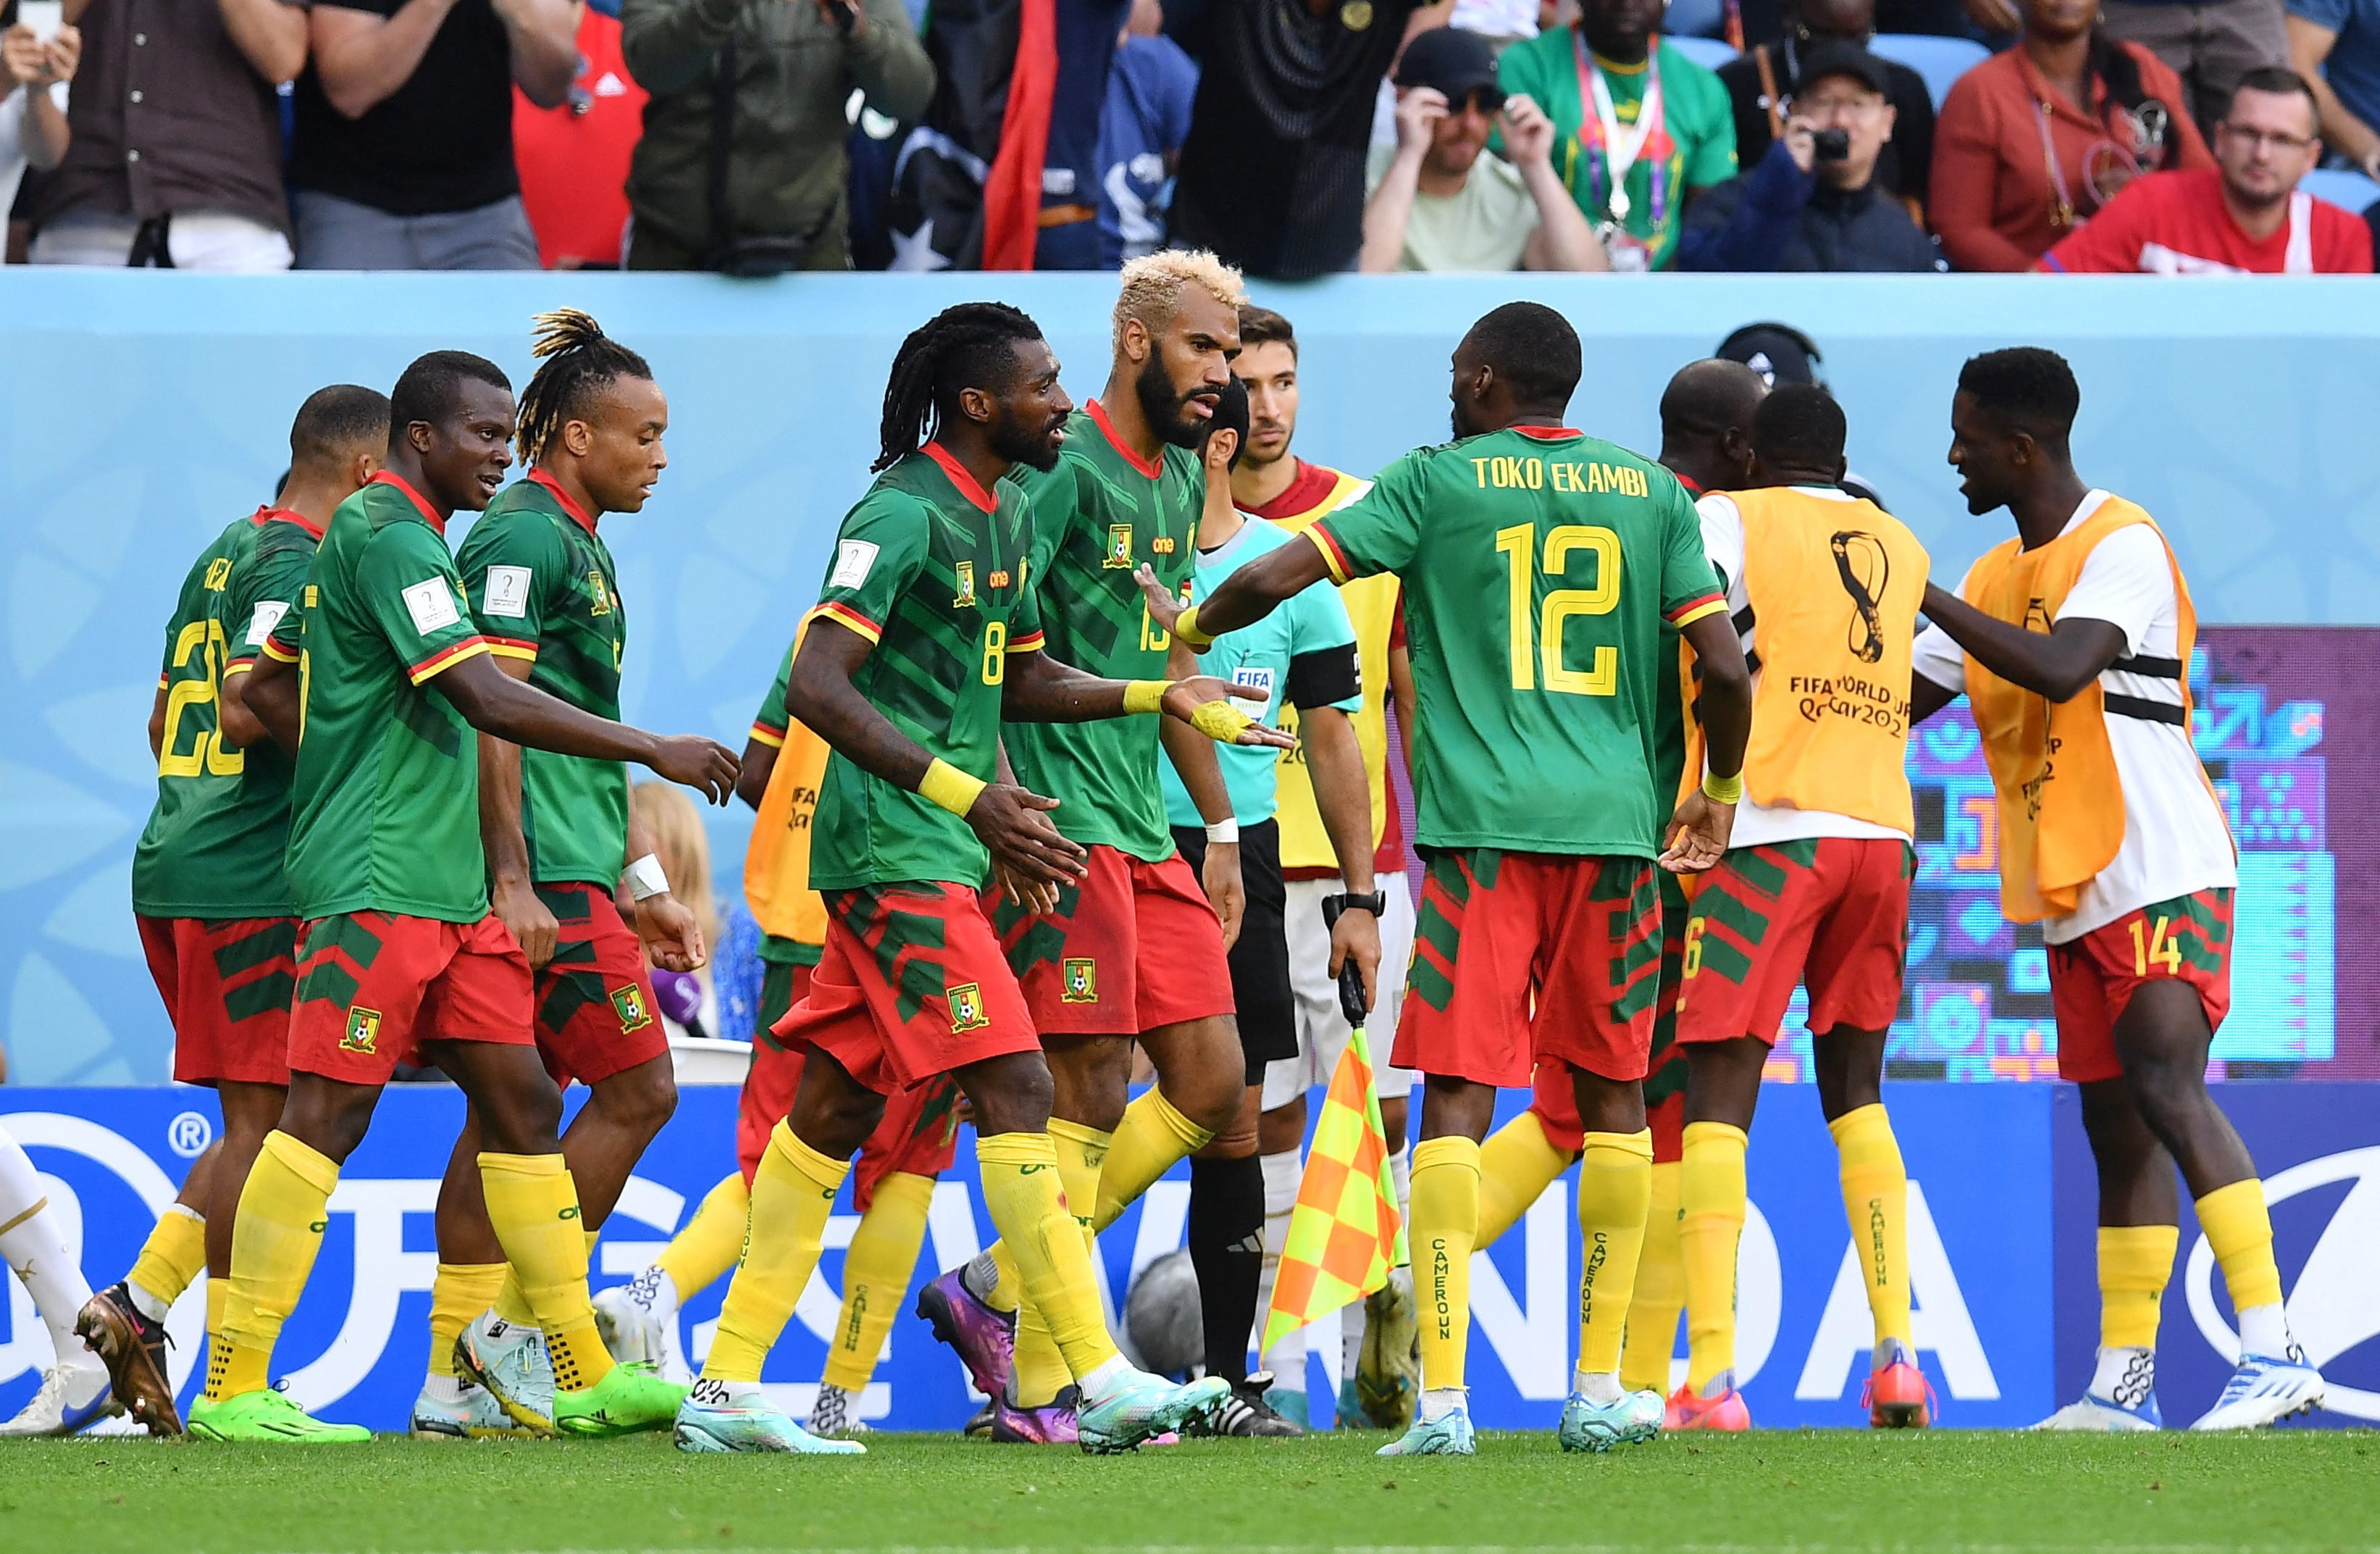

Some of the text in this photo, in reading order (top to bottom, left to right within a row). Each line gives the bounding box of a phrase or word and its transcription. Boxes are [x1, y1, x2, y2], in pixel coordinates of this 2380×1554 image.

[1470, 456, 1648, 498] TOKO EKAMBI
[1153, 538, 1174, 553] one
[990, 572, 1009, 588] one
[1496, 522, 1622, 696] 12
[982, 621, 1006, 686] 8
[1237, 672, 1269, 687] FIFA
[1790, 677, 1833, 695] FIFA
[1837, 675, 1891, 704] ORLD
[2128, 916, 2182, 977] 14
[928, 1179, 2001, 1400] WNA
[1432, 1238, 1450, 1340] CAMEROUN
[1581, 1232, 1607, 1324] CAMEROUN
